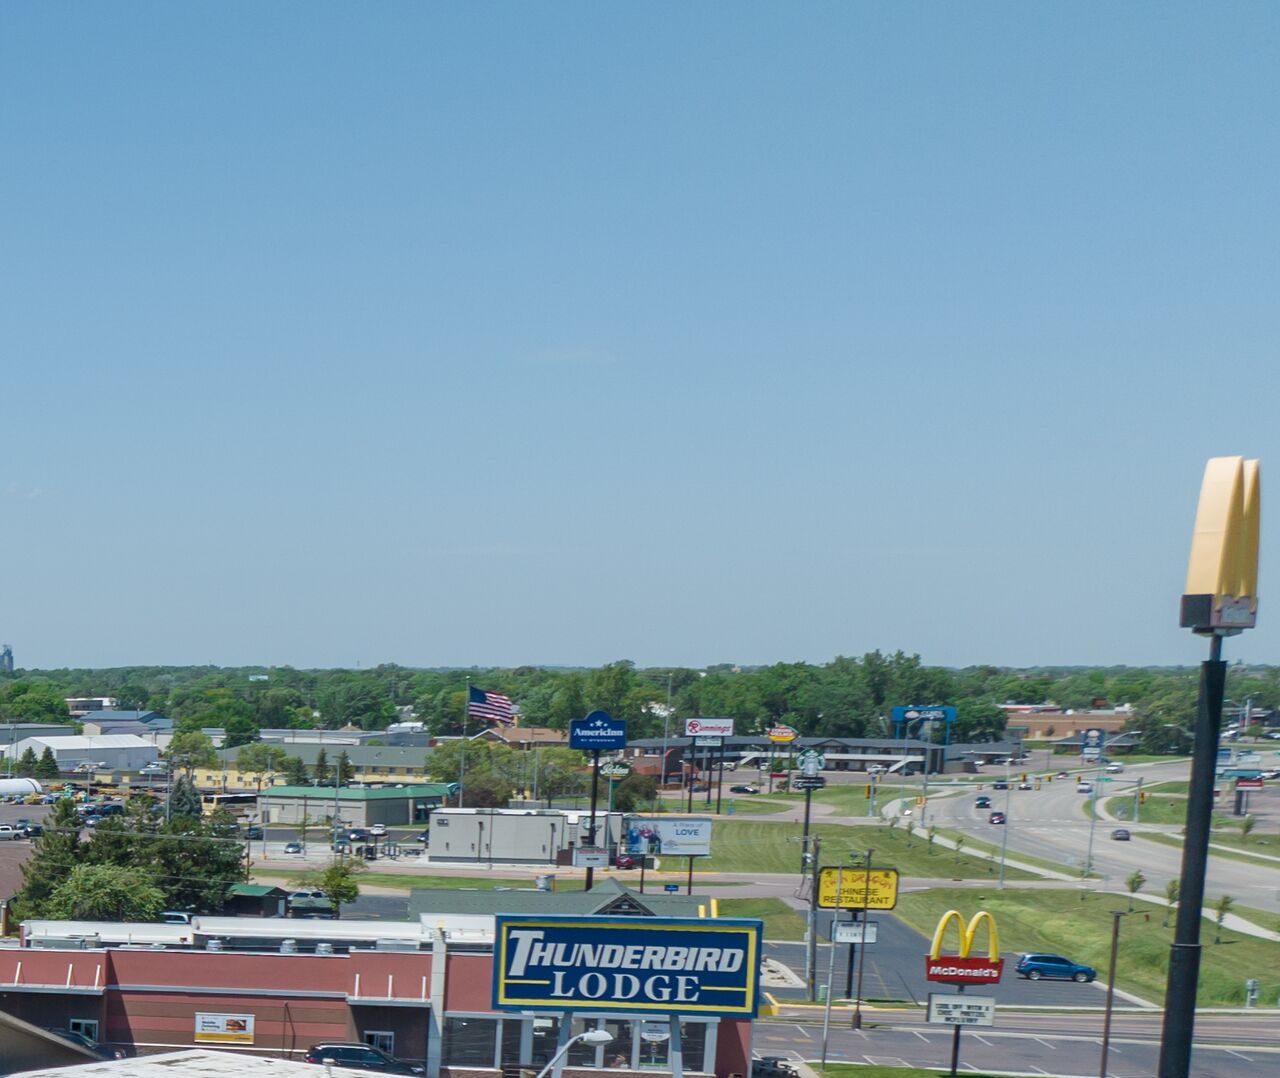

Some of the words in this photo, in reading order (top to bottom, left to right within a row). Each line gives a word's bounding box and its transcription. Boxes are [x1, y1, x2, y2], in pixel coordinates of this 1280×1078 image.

[573, 728, 624, 736] AmericInn
[688, 720, 731, 734] Runnings
[836, 887, 880, 896] CHINESE
[823, 896, 890, 905] RESTAURANT
[929, 966, 999, 977] McDonald's
[550, 971, 700, 1002] LODGE
